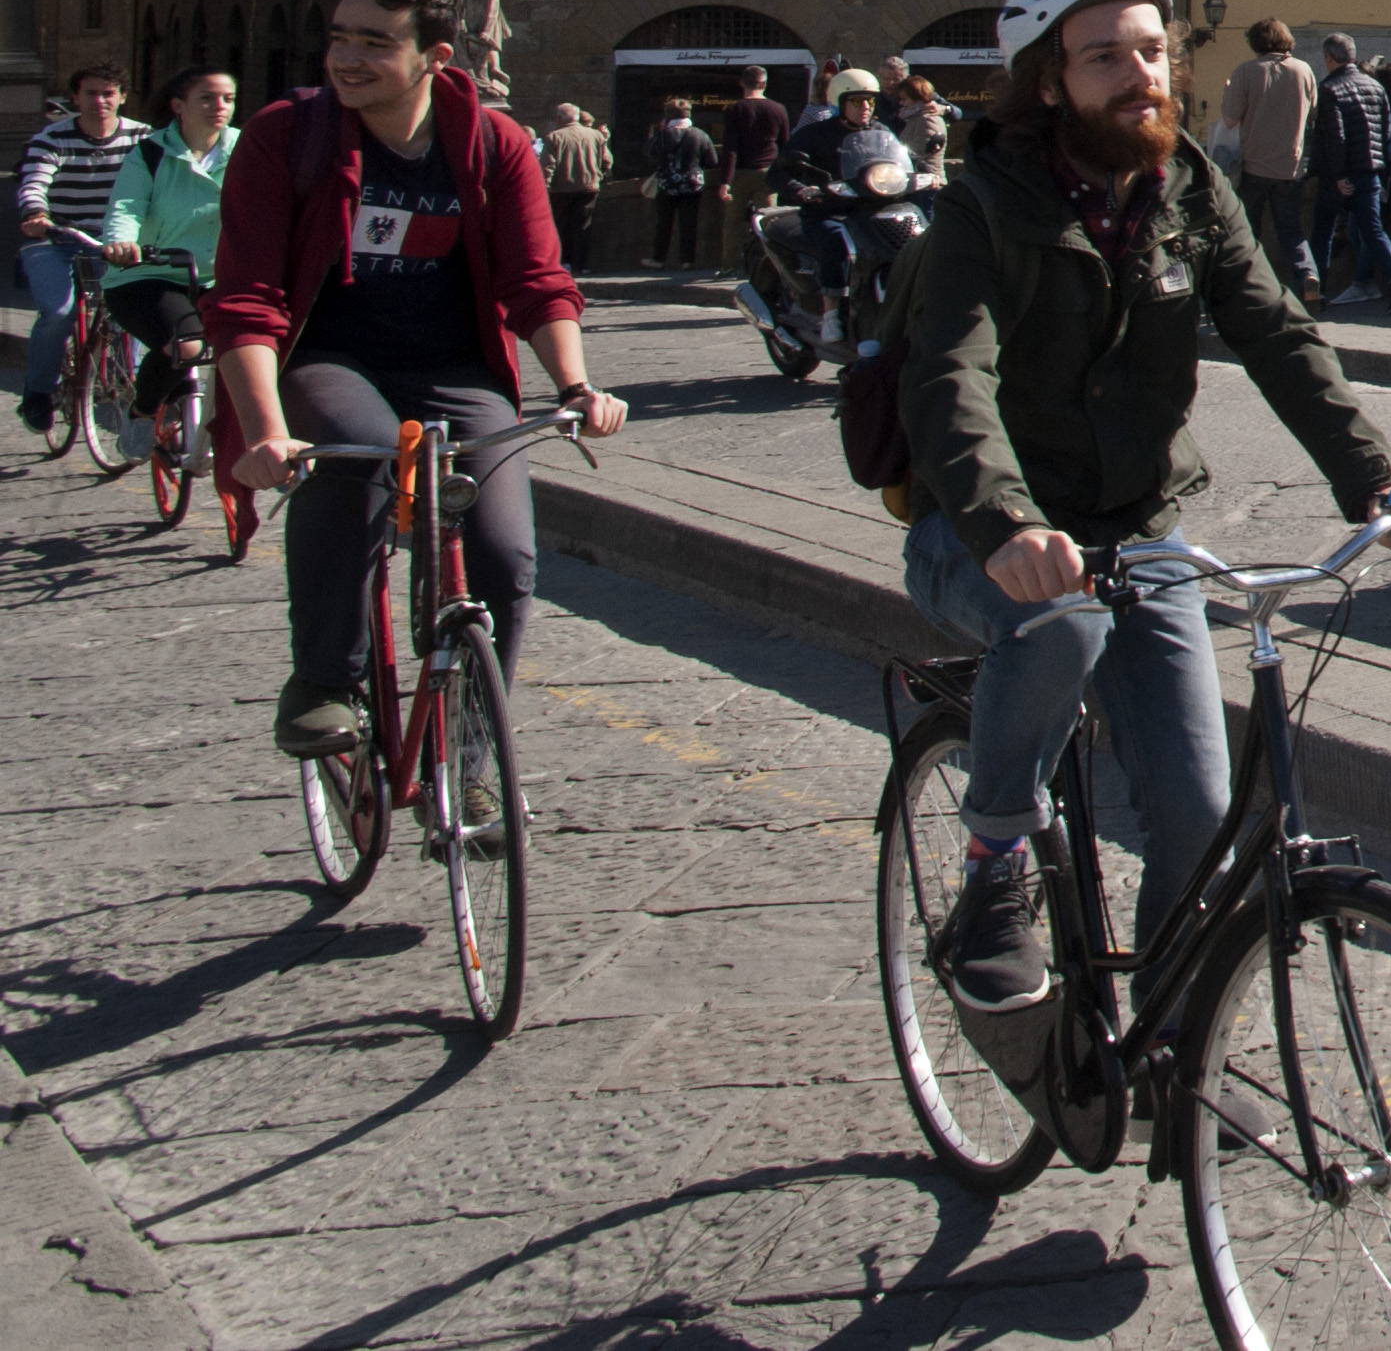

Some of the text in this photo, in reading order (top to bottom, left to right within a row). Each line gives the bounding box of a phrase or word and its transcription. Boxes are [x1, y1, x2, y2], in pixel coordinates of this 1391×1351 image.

[708, 50, 750, 64] Ferragamo
[361, 185, 462, 213] ENNA
[350, 255, 438, 274] STRIA
